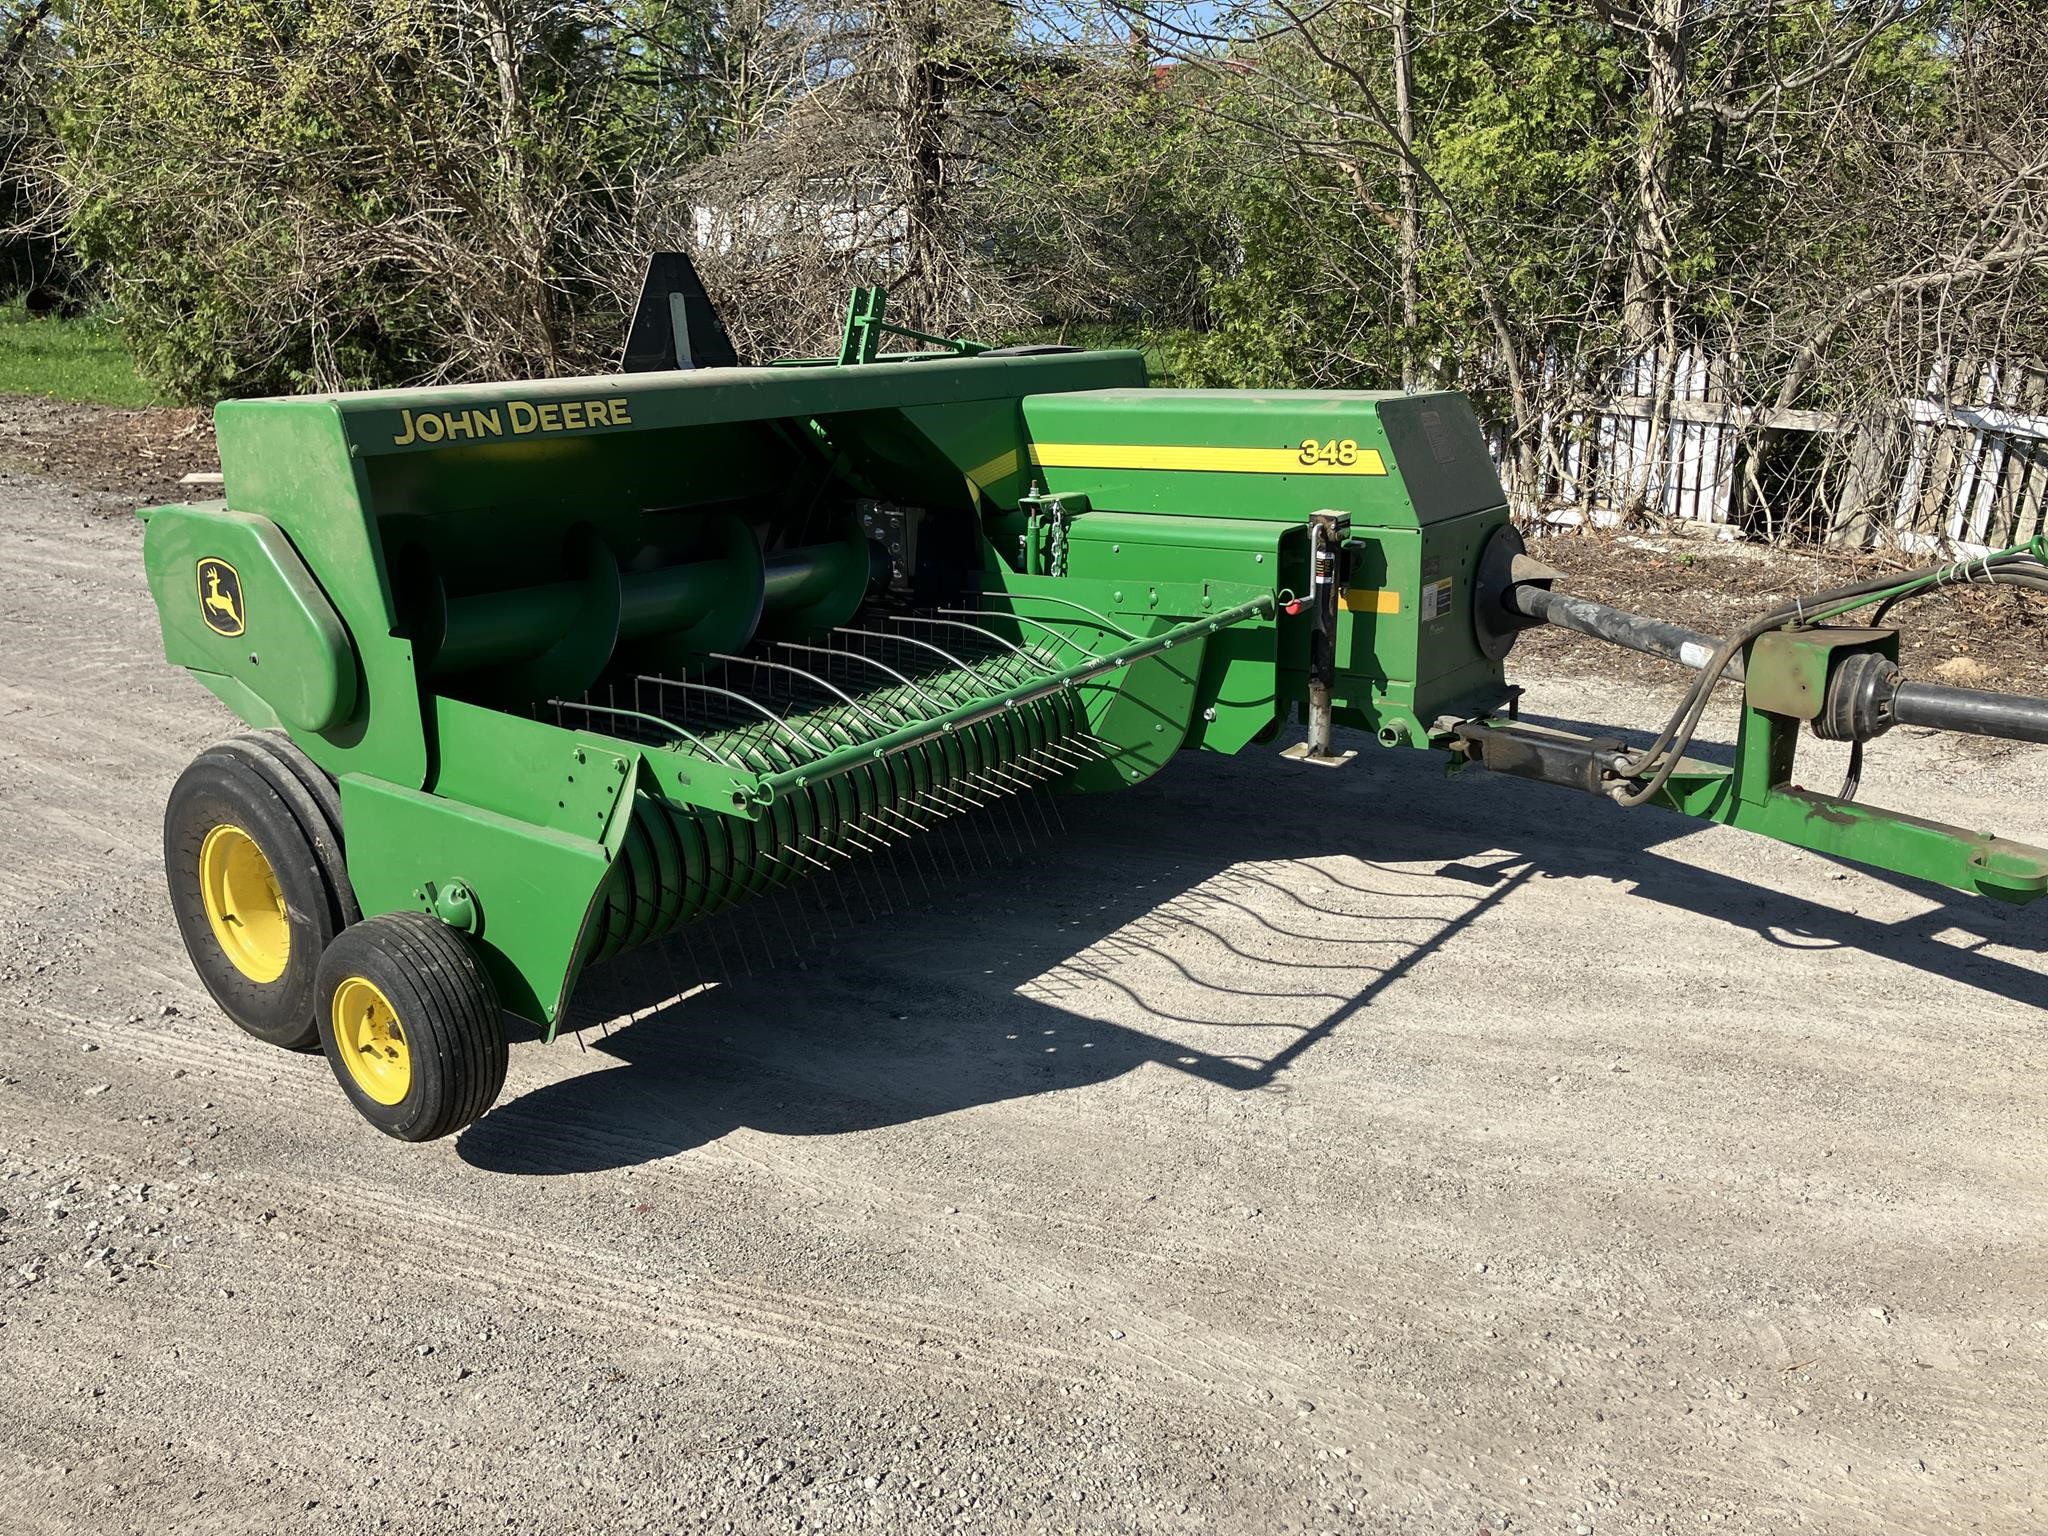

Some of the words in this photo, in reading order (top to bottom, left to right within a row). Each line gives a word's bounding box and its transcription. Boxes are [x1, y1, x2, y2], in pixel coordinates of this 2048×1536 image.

[393, 408, 503, 446] JOHN
[507, 398, 632, 434] DEERE
[1299, 439, 1358, 466] 348
